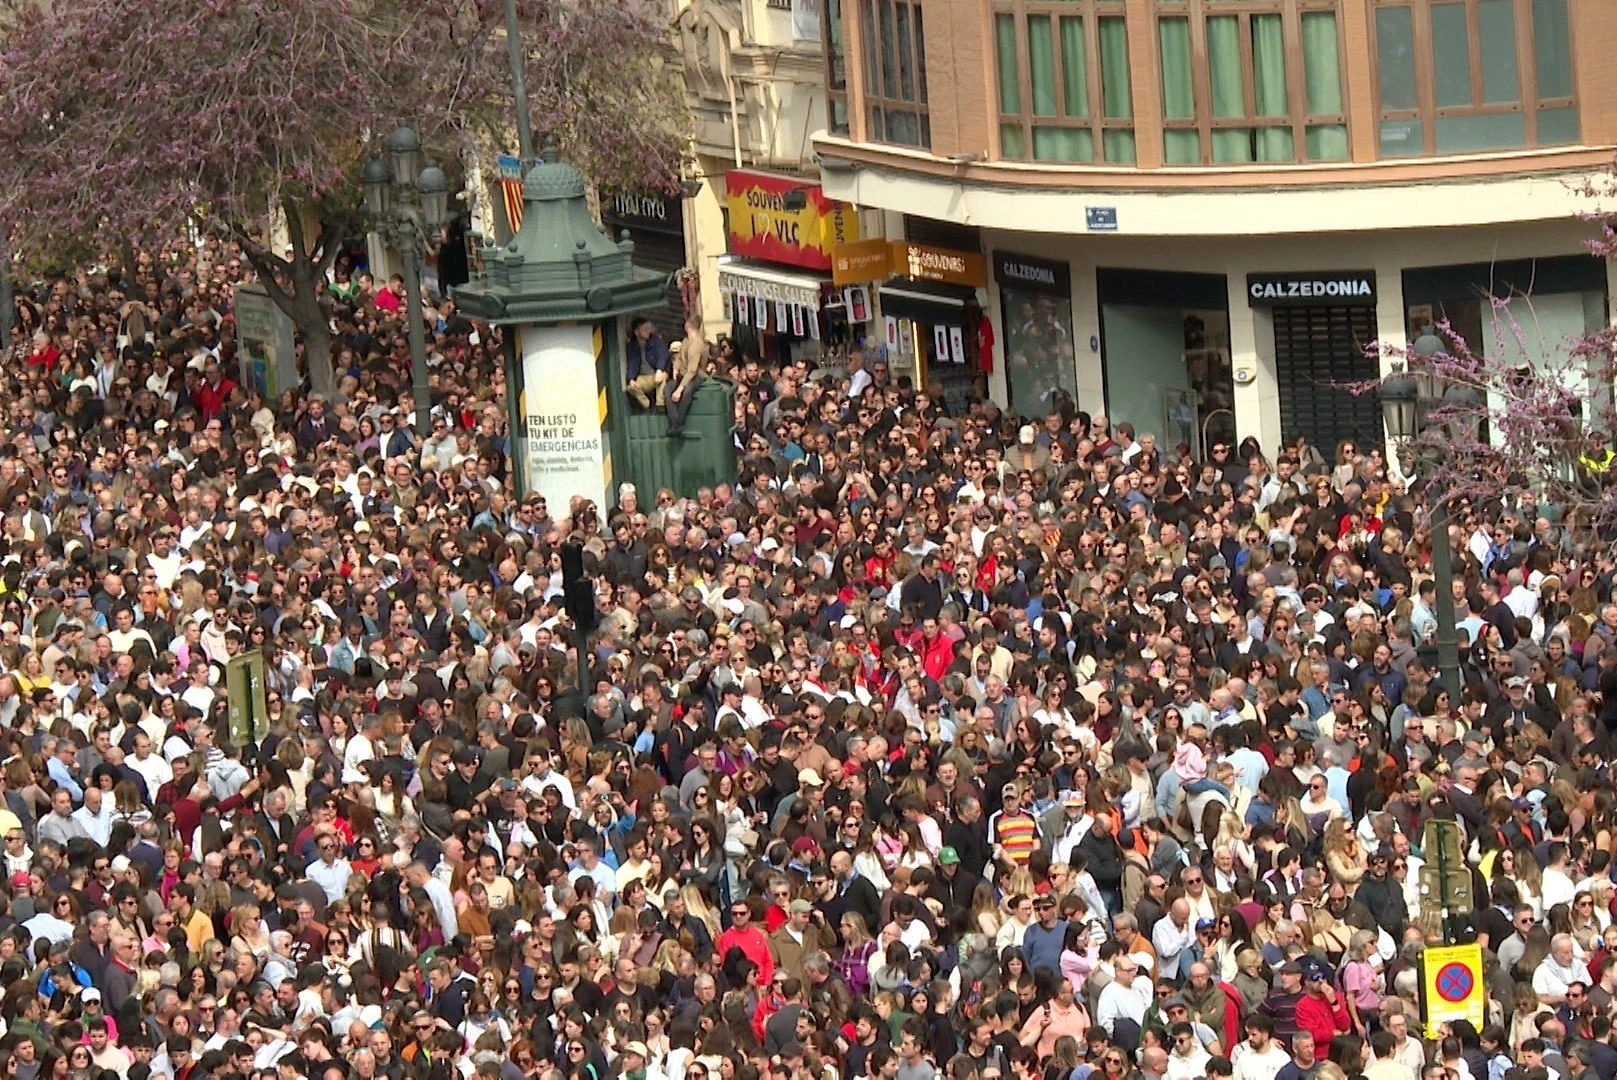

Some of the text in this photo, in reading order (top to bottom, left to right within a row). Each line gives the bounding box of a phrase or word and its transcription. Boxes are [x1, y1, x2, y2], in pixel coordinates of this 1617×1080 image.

[746, 190, 800, 215] SOUVEN
[775, 219, 800, 244] VLC
[1003, 262, 1056, 284] CALZEDONIA
[1250, 279, 1372, 298] CALZEDONIA
[528, 413, 577, 426] TEN LISTO
[529, 427, 575, 439] TU KIT DE
[530, 438, 598, 452] EMERGENCIAS
